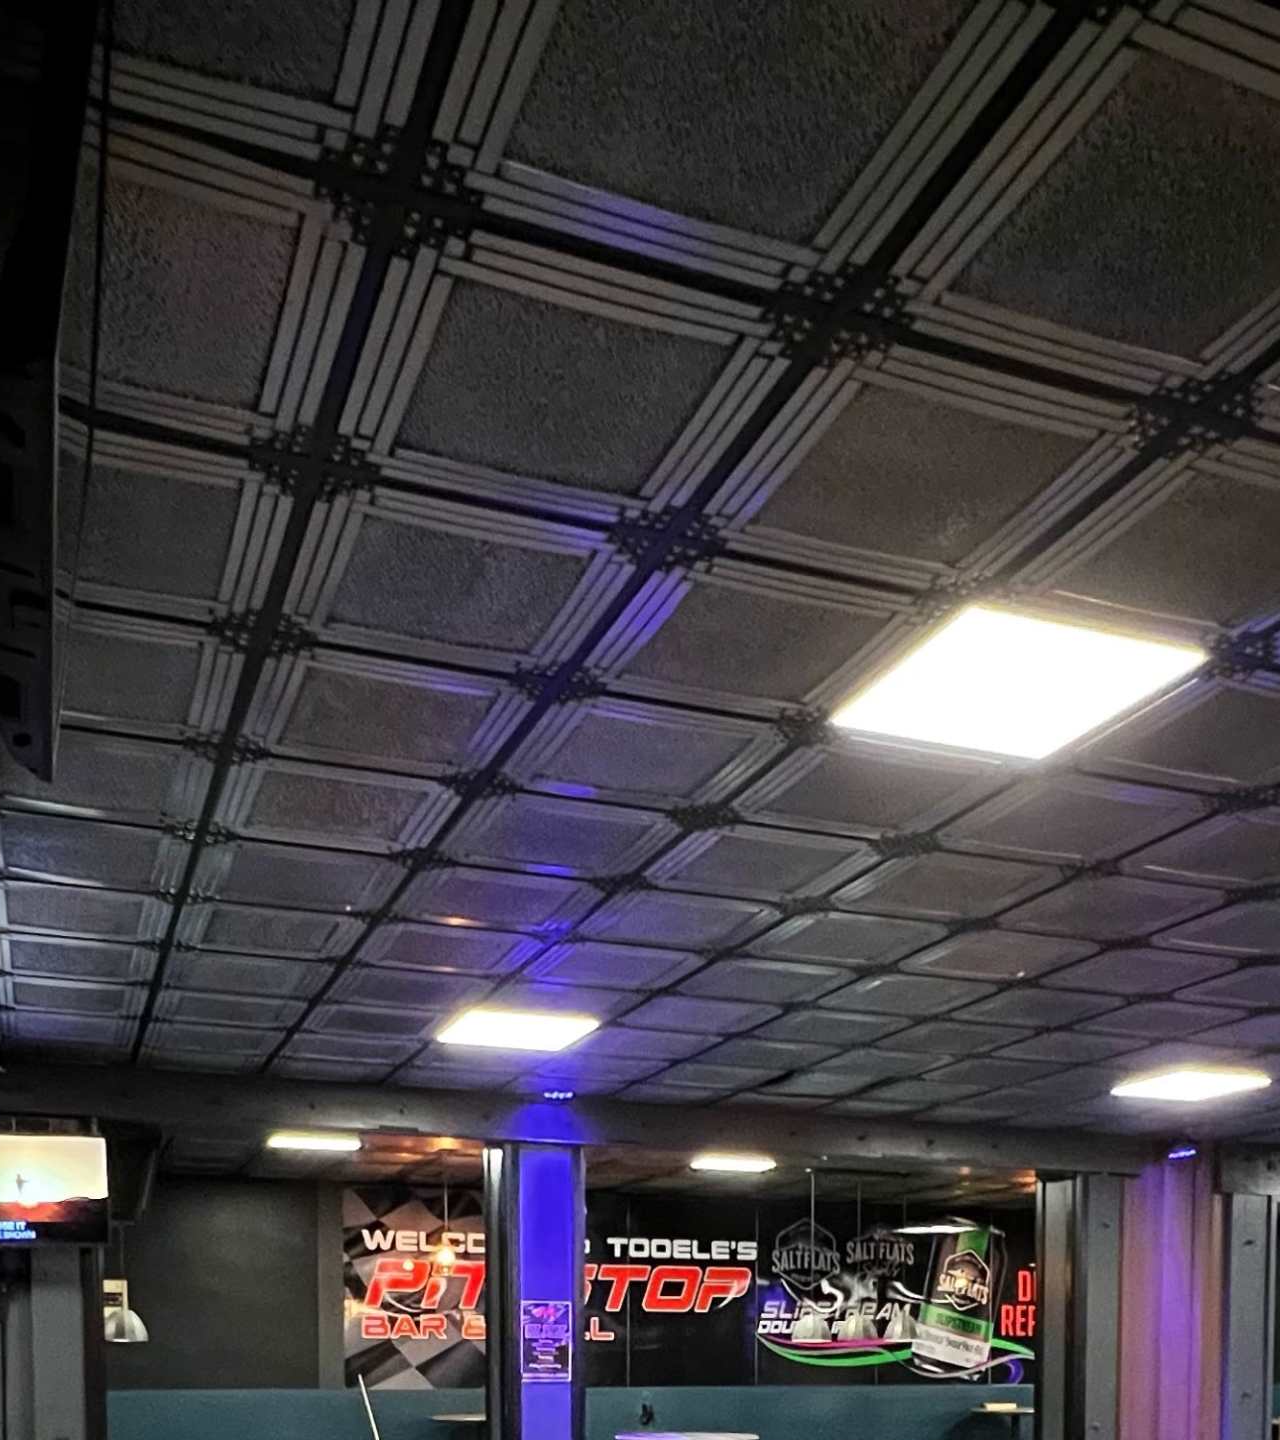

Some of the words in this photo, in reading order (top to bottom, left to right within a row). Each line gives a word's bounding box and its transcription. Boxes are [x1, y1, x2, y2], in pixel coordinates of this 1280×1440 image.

[362, 1229, 486, 1253] WELCO
[846, 1241, 876, 1264] SALT
[879, 1243, 915, 1265] FLATS
[361, 1313, 448, 1339] BAR
